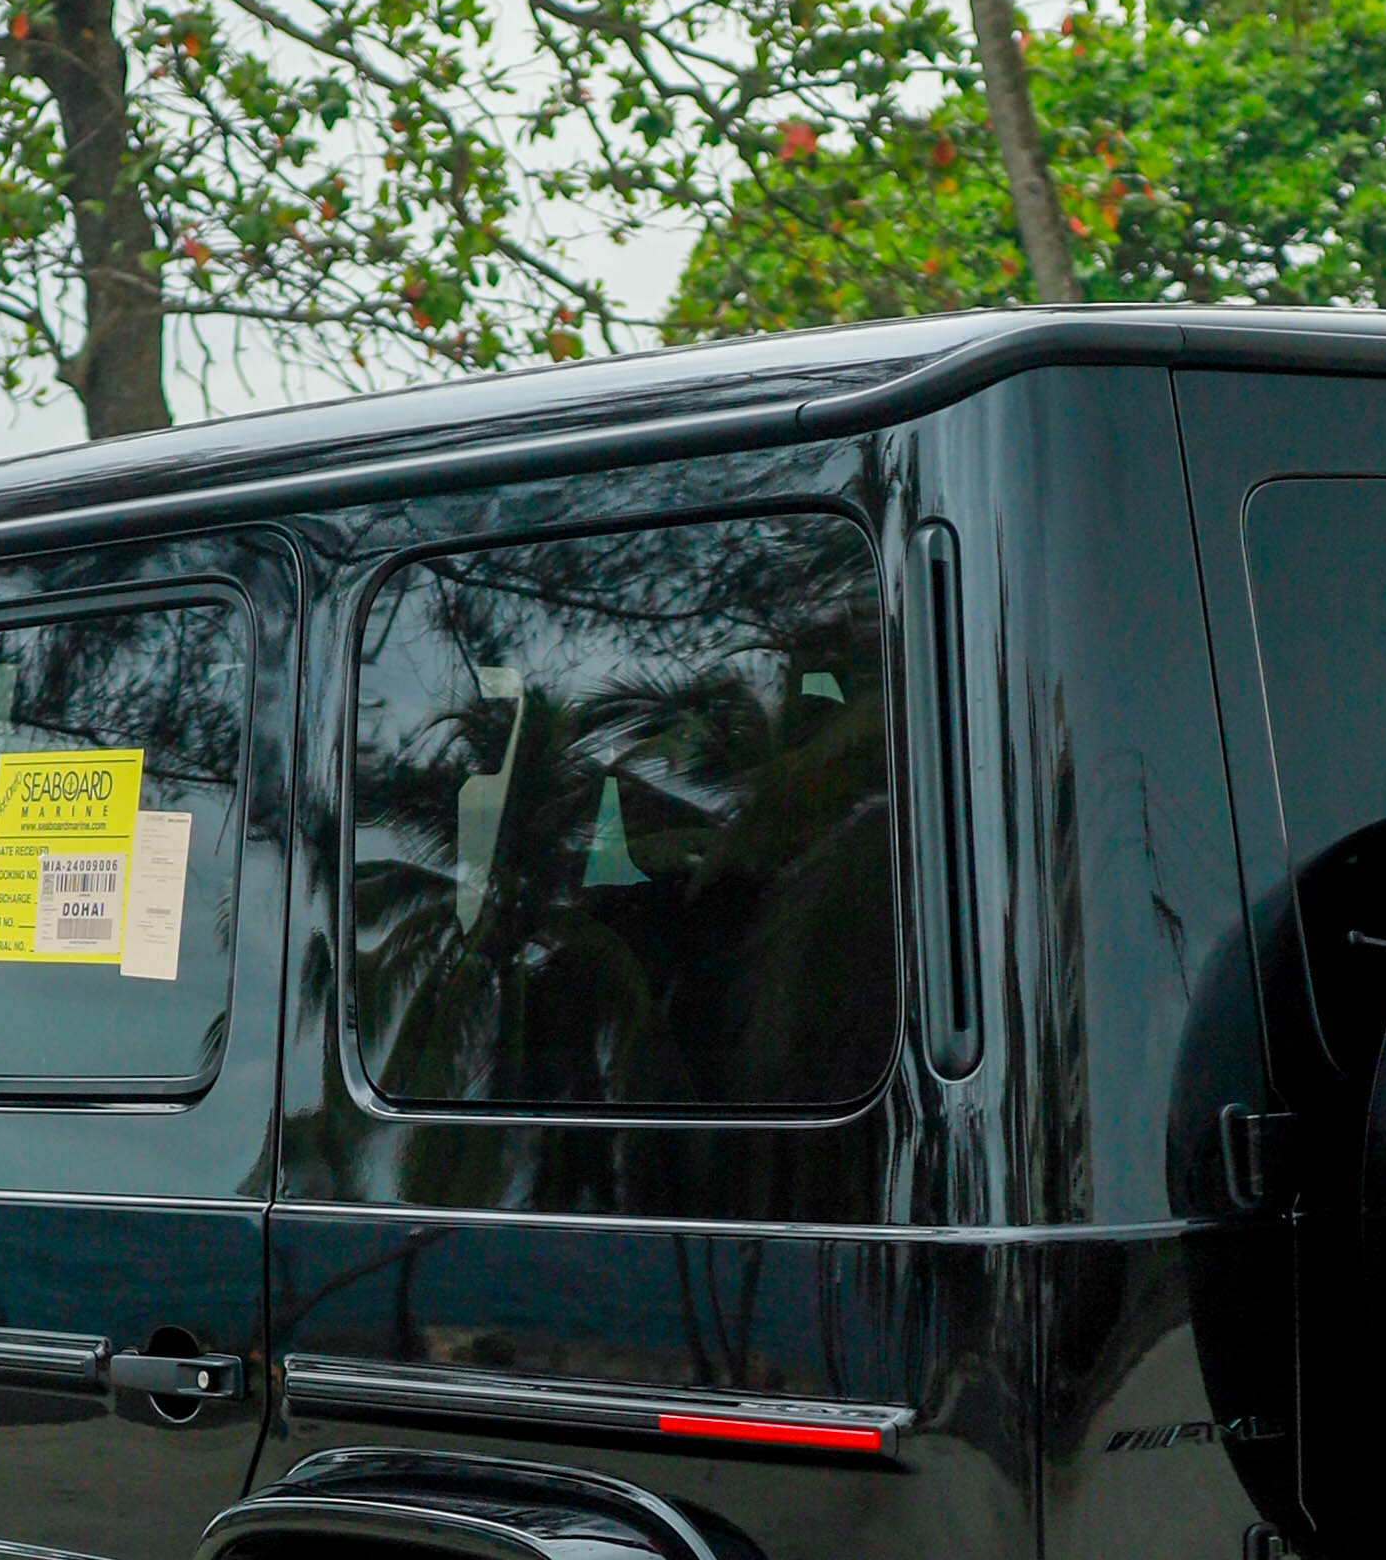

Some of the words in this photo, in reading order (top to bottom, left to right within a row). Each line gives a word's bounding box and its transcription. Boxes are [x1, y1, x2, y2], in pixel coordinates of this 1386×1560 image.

[21, 770, 113, 802] SEABOARD
[21, 805, 109, 817] MARINE
[21, 821, 107, 831] www.seaboardmarine.com
[42, 859, 118, 872] MIA-24009006
[62, 902, 105, 916] DOHAI
